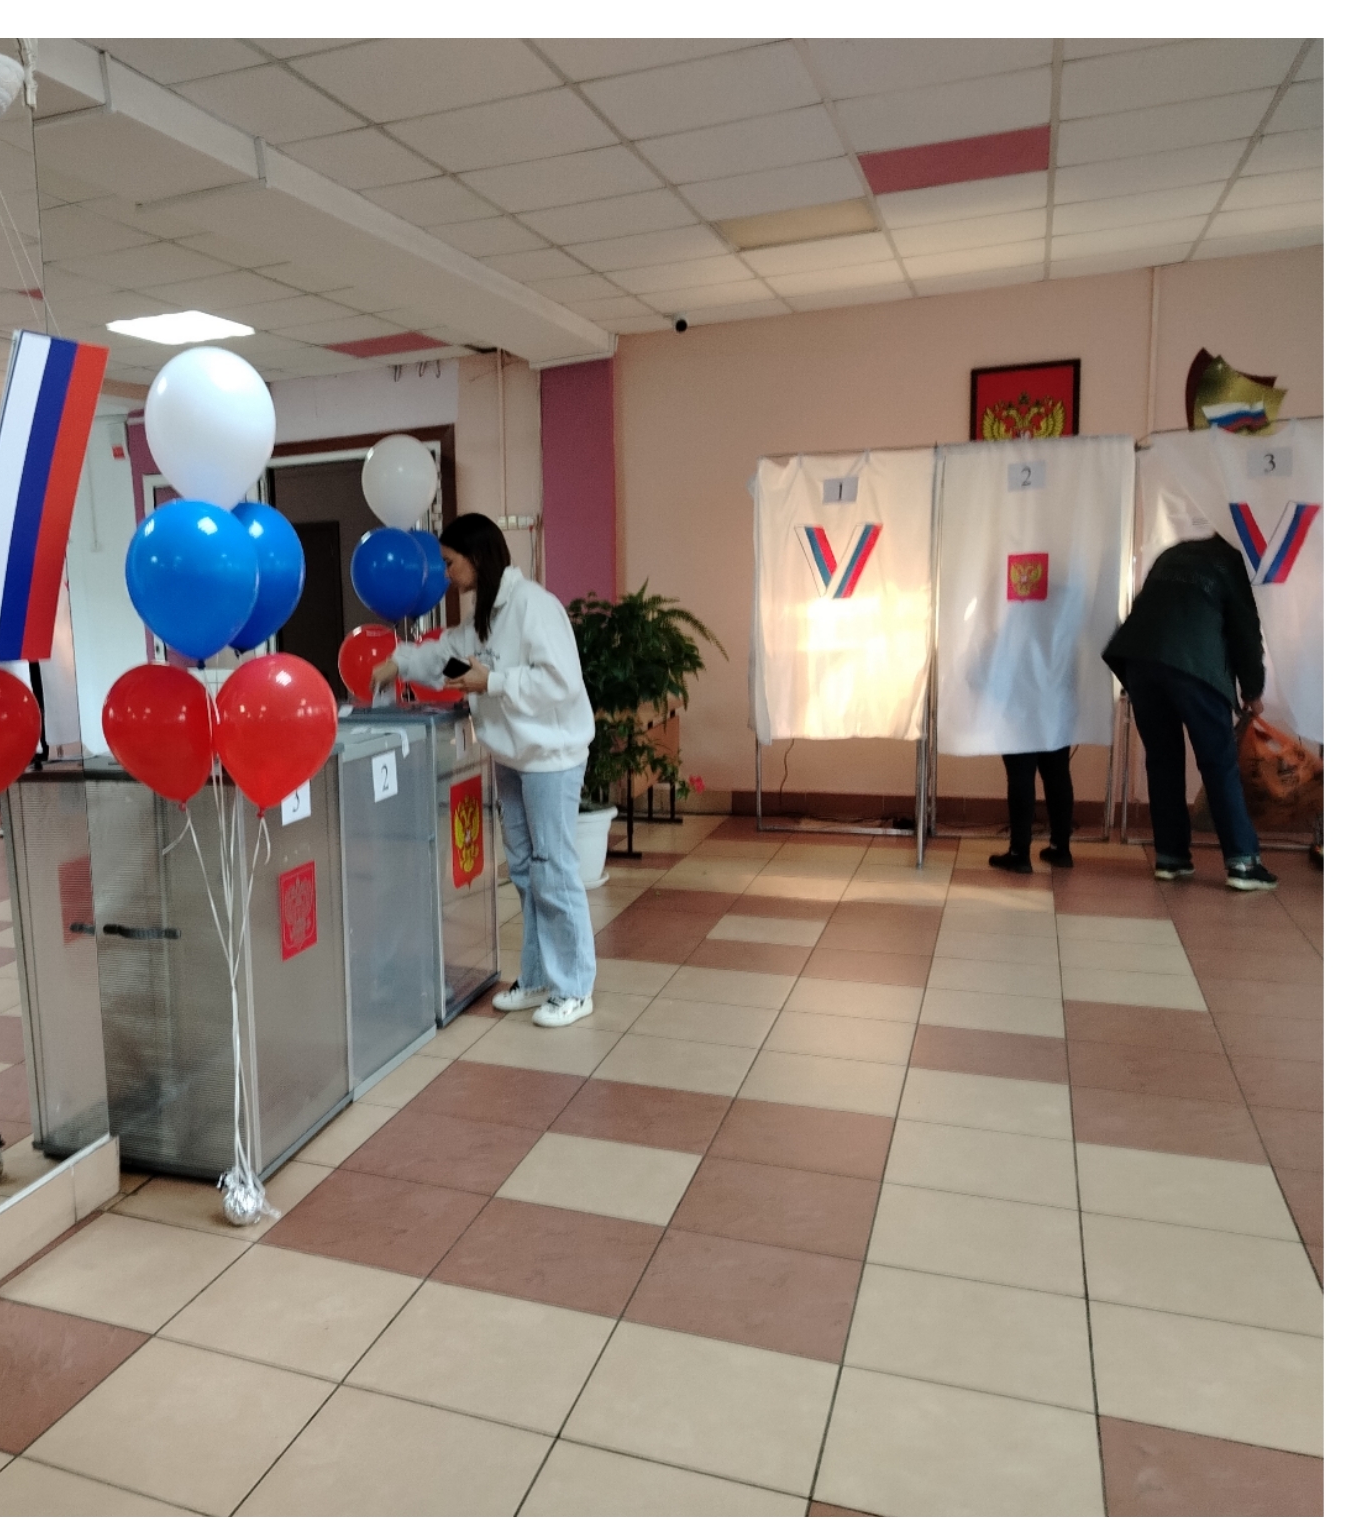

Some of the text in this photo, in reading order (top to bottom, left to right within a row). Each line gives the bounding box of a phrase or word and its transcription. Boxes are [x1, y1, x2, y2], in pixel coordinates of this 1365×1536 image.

[1263, 454, 1276, 473] 3
[1020, 466, 1033, 487] 2
[837, 482, 843, 501] 1
[380, 763, 390, 793] 2
